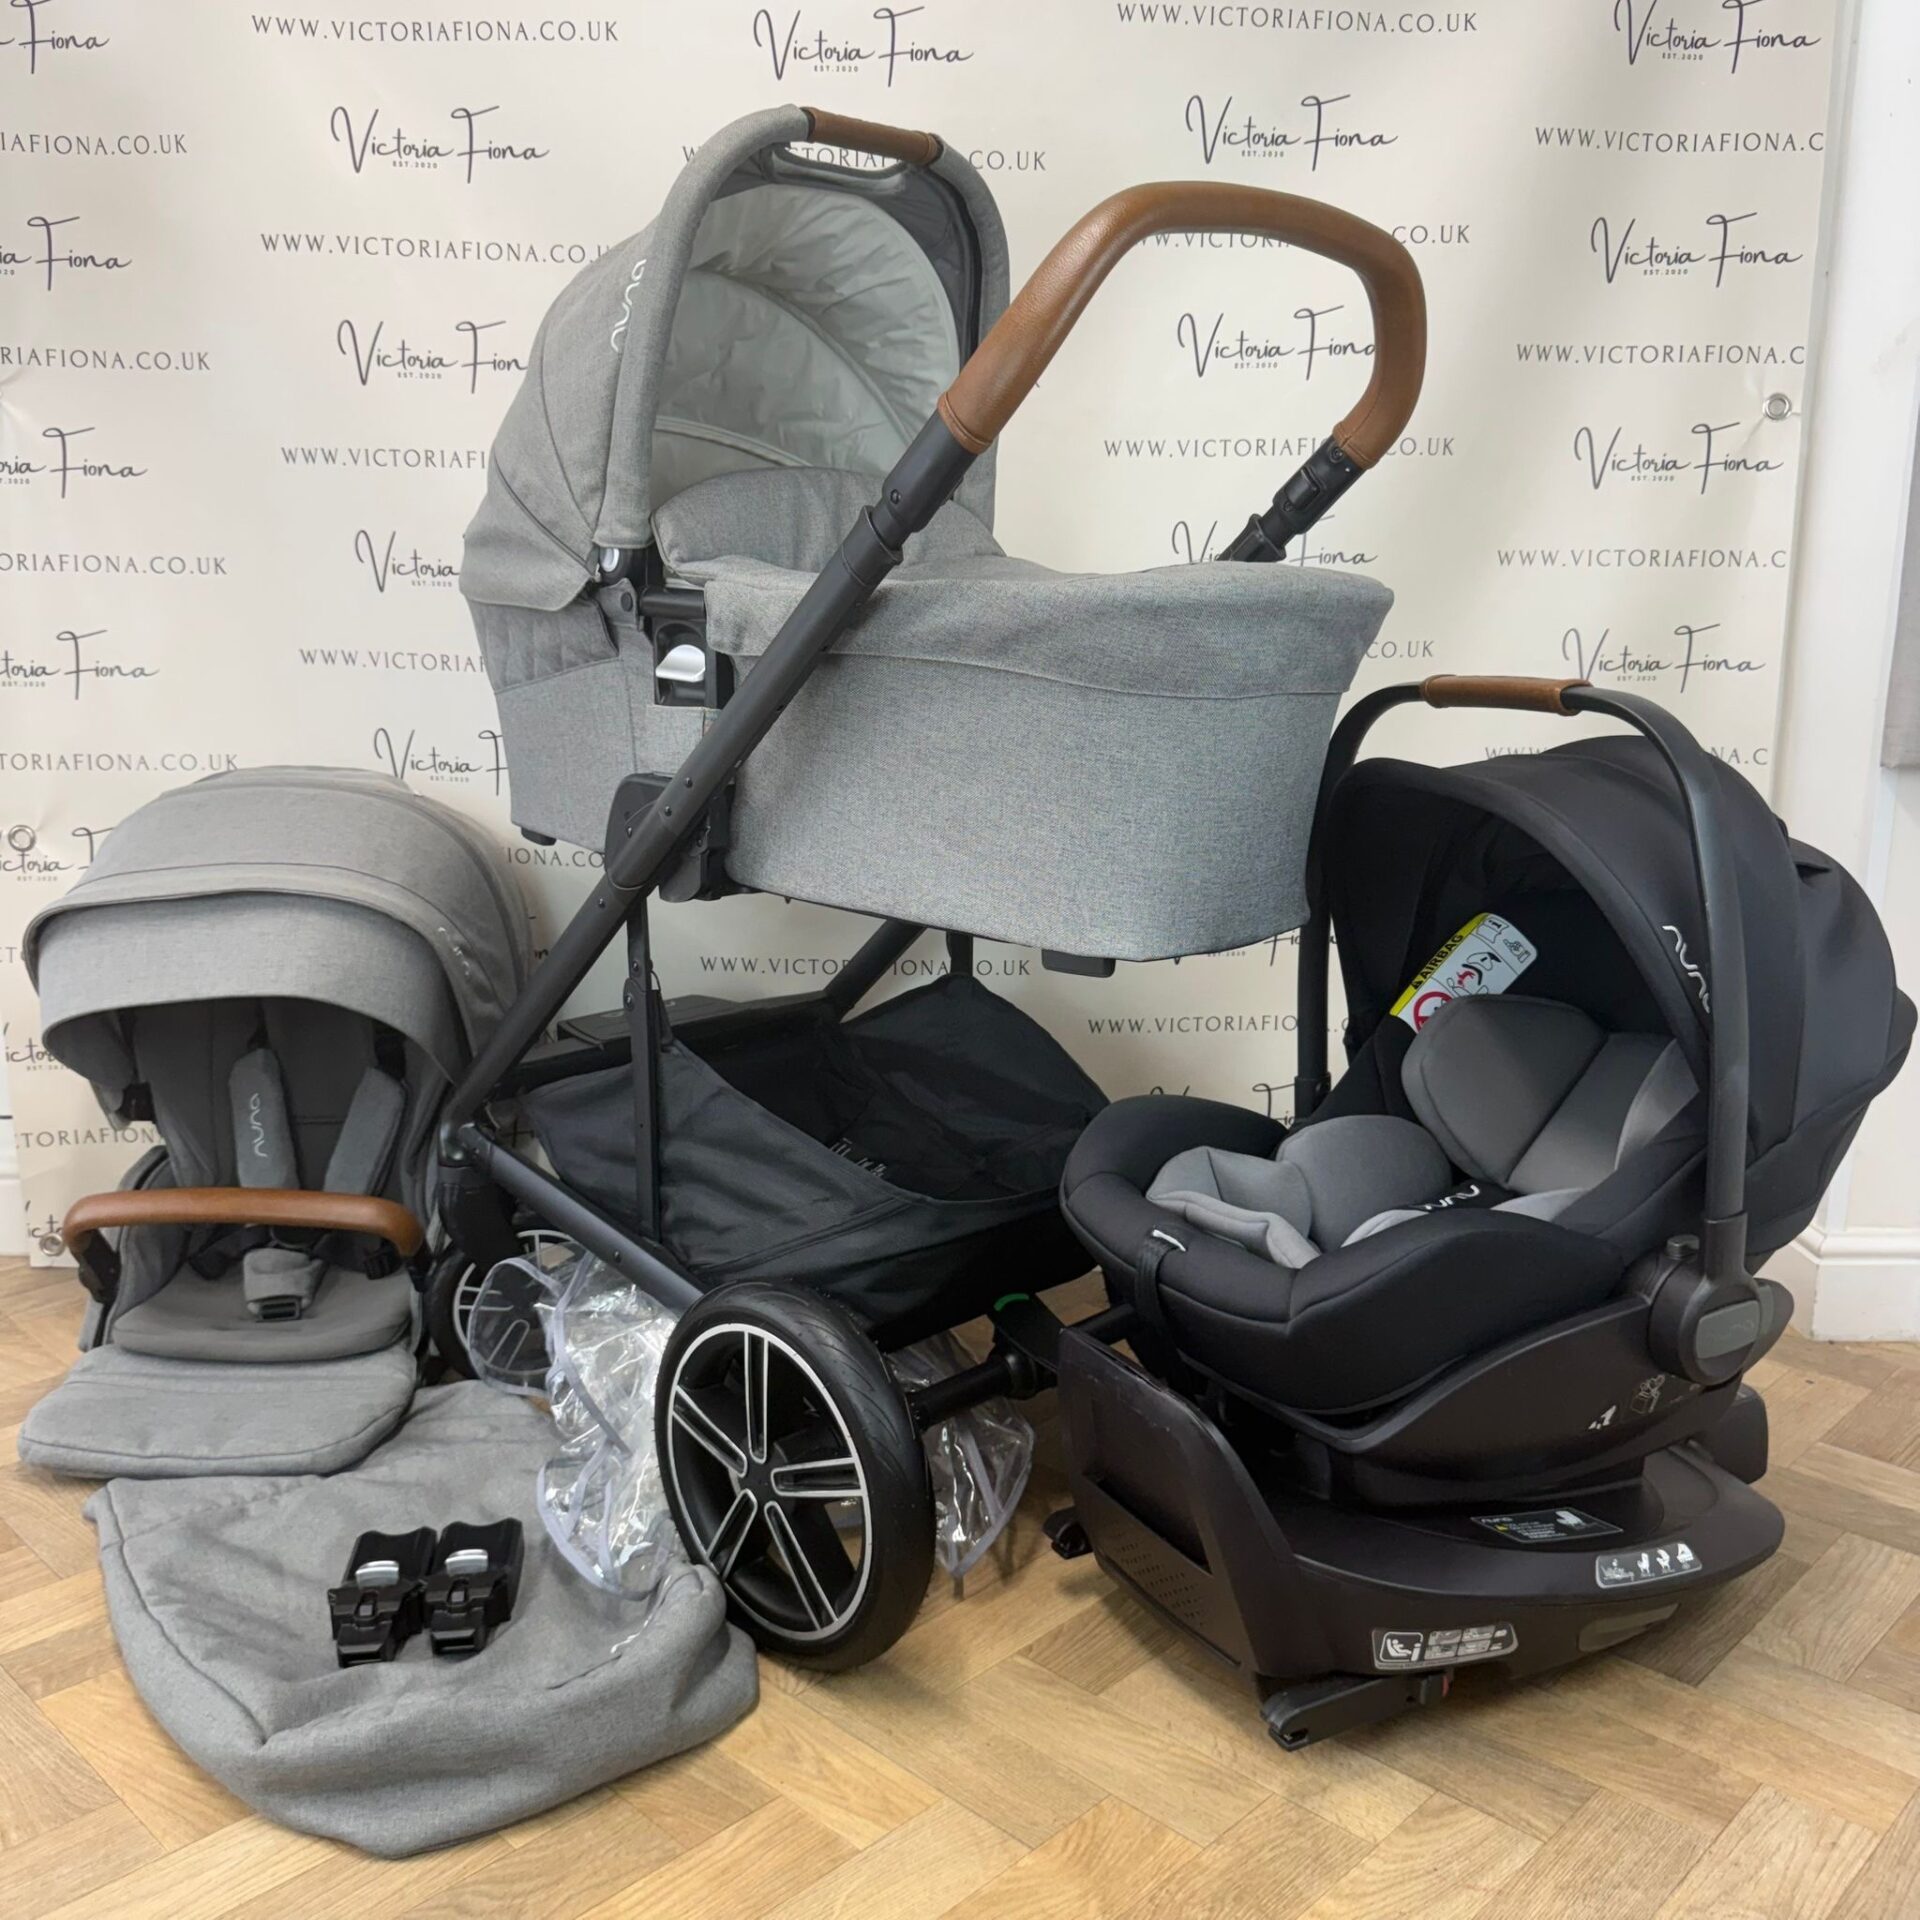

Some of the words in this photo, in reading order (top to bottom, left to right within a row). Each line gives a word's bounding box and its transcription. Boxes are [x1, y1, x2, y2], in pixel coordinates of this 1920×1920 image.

[10, 0, 110, 74] Fiona
[252, 15, 619, 42] WWW.VICTORIAFIONA.CO.UK
[753, 9, 875, 80] Victoria
[873, 6, 974, 87] Fiona
[1117, 3, 1478, 33] WWW.VICTORIAFIONA.CO.UK
[1614, 0, 1721, 65] Victoria
[1722, 0, 1821, 74] Fiona
[331, 106, 454, 173] Victoria
[451, 105, 549, 183] Fiona
[1186, 95, 1301, 164] Victoria
[1301, 94, 1398, 171] Fiona
[27, 216, 132, 291] Fiona
[1591, 217, 1706, 283] Victoria
[1706, 212, 1803, 288] Fiona
[337, 319, 459, 386] Victoria
[1177, 313, 1295, 378] Victoria
[42, 427, 148, 499] Fiona
[1574, 427, 1691, 490] Victoria
[1692, 422, 1784, 495] Fiona
[355, 530, 461, 593] Victoria
[56, 629, 160, 700] Fiona
[1562, 628, 1673, 683] Victoria
[1675, 624, 1766, 693] Fiona
[1421, 934, 1464, 980] AIRBAG
